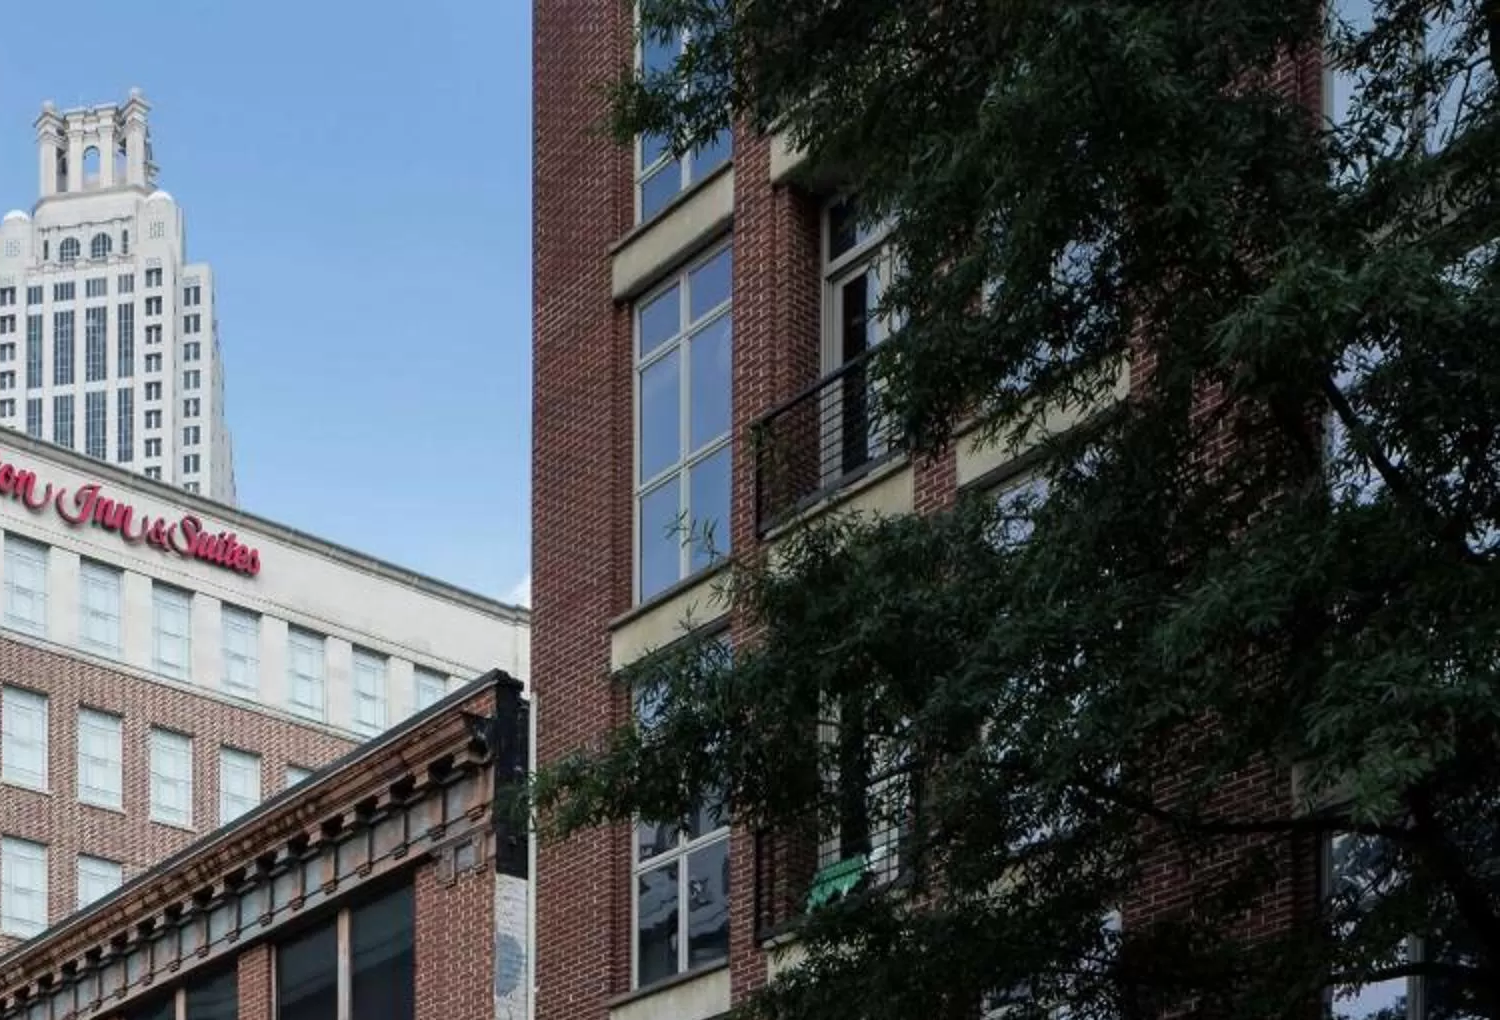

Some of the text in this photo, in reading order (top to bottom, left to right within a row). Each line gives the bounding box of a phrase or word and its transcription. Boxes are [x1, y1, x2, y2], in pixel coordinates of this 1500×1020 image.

[56, 483, 149, 544] Inn
[146, 517, 170, 552] &
[168, 514, 261, 578] Suites
